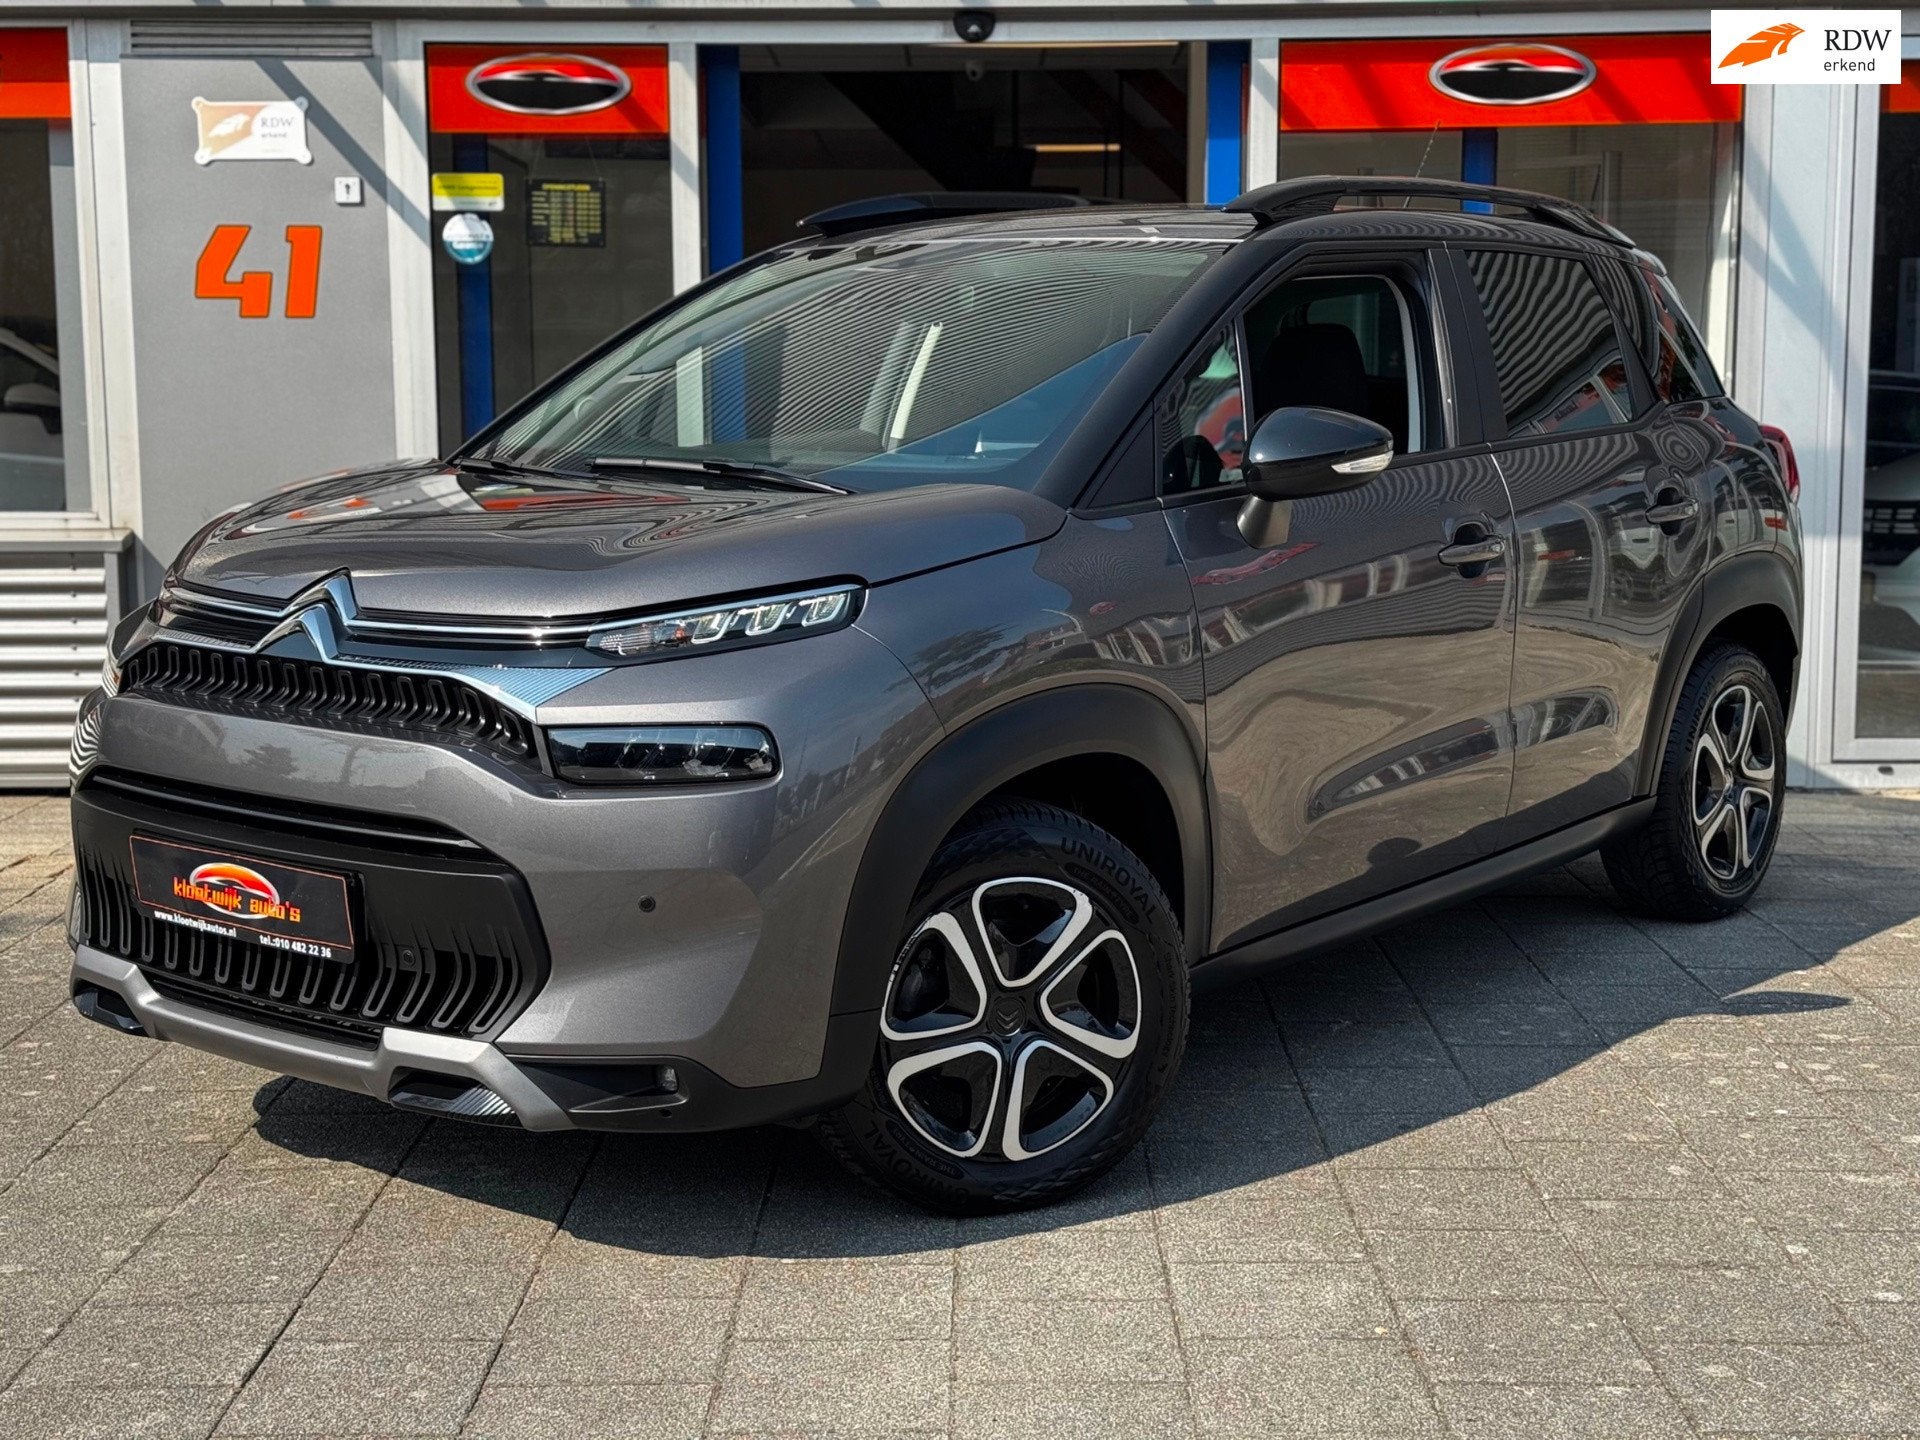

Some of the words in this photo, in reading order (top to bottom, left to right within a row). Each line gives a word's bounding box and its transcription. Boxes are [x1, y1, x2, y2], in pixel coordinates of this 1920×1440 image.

[260, 116, 295, 128] RDW
[194, 225, 323, 319] 41
[1059, 836, 1157, 925] UNIROYAL
[173, 877, 243, 912] klootwijk
[249, 900, 301, 923] auto's
[153, 910, 237, 938] www.klootwijkautos.nl
[291, 941, 307, 955] 482
[308, 944, 319, 956] 22
[320, 947, 332, 959] 36
